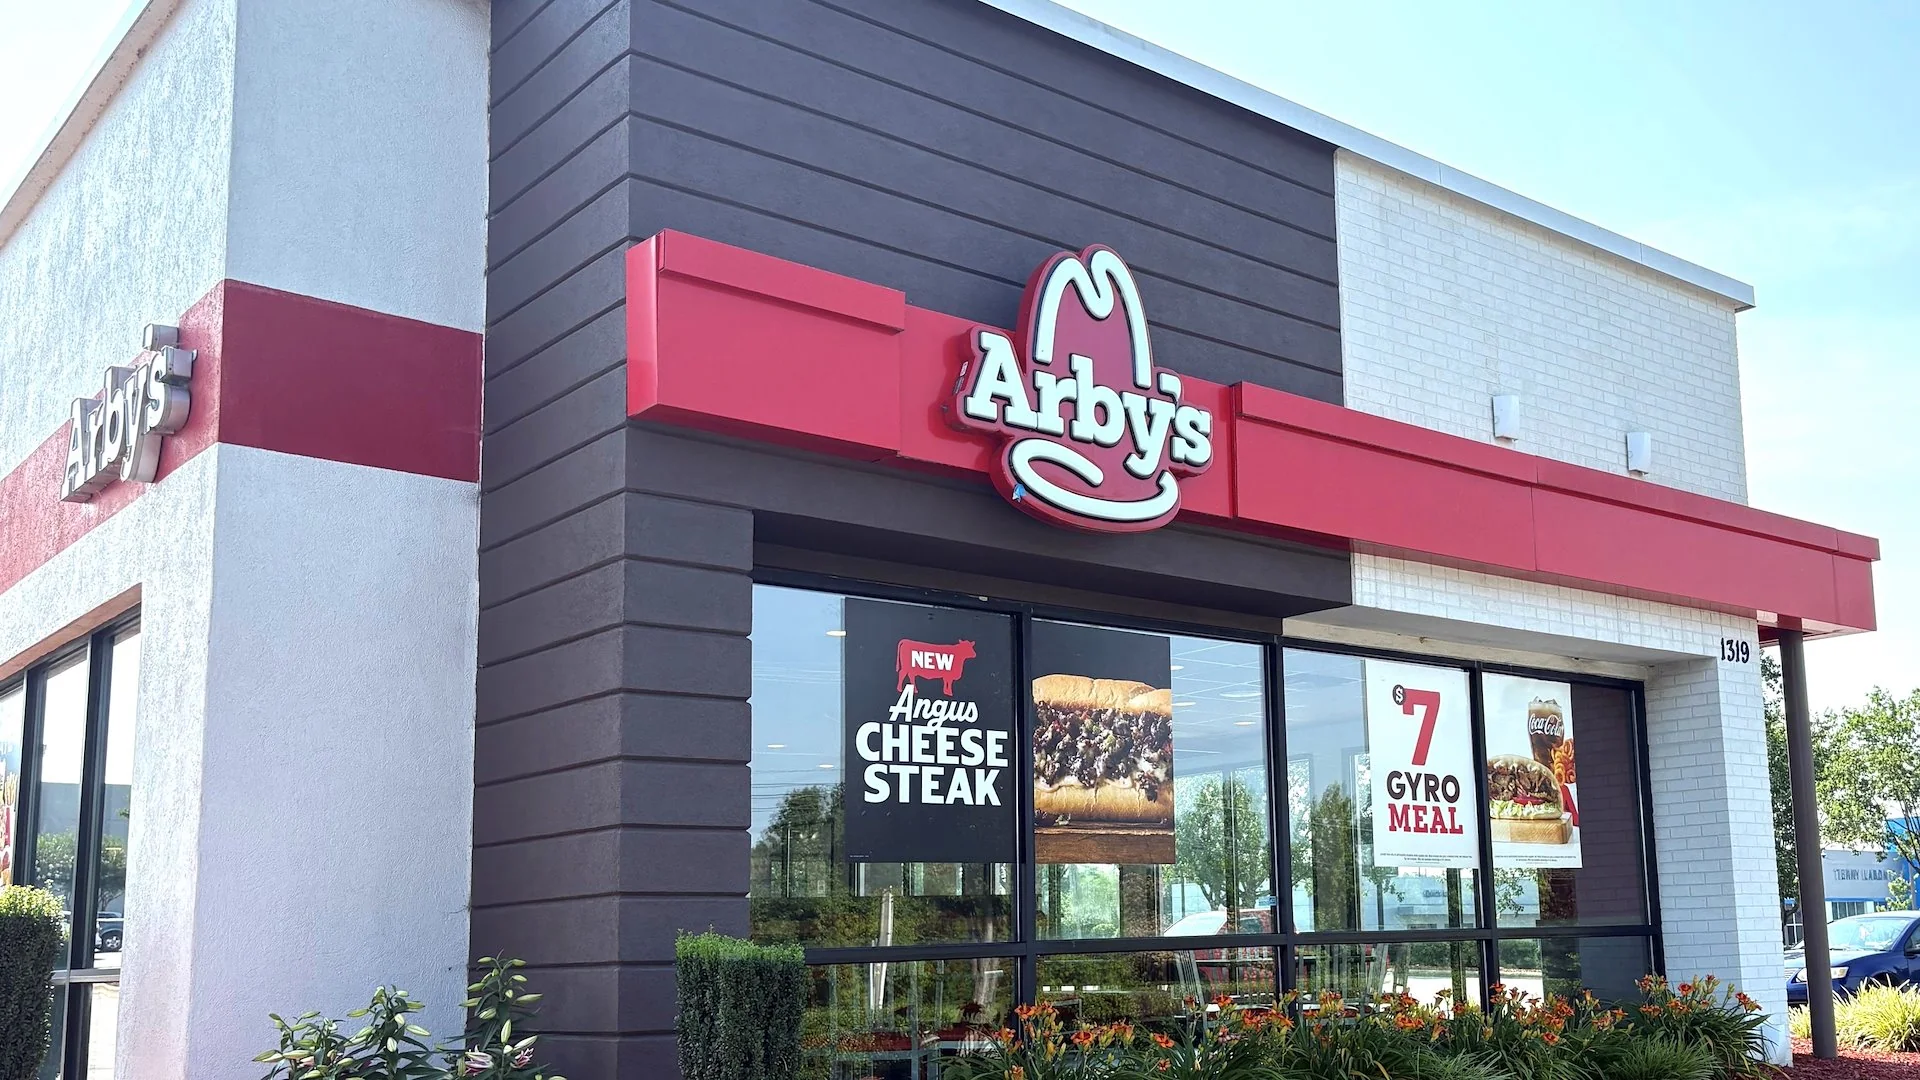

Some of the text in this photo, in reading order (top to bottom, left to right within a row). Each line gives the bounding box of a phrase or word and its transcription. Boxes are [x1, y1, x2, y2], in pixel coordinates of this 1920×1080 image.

[60, 323, 190, 502] Arby's
[964, 331, 1213, 478] Arby's
[911, 650, 955, 672] NEW
[1721, 637, 1750, 664] 1319
[889, 684, 978, 731] Angus
[855, 721, 1009, 768] CHEESE
[863, 764, 1002, 806] STEAK
[1386, 770, 1461, 804] GYRO
[1388, 804, 1464, 835] MEAL
